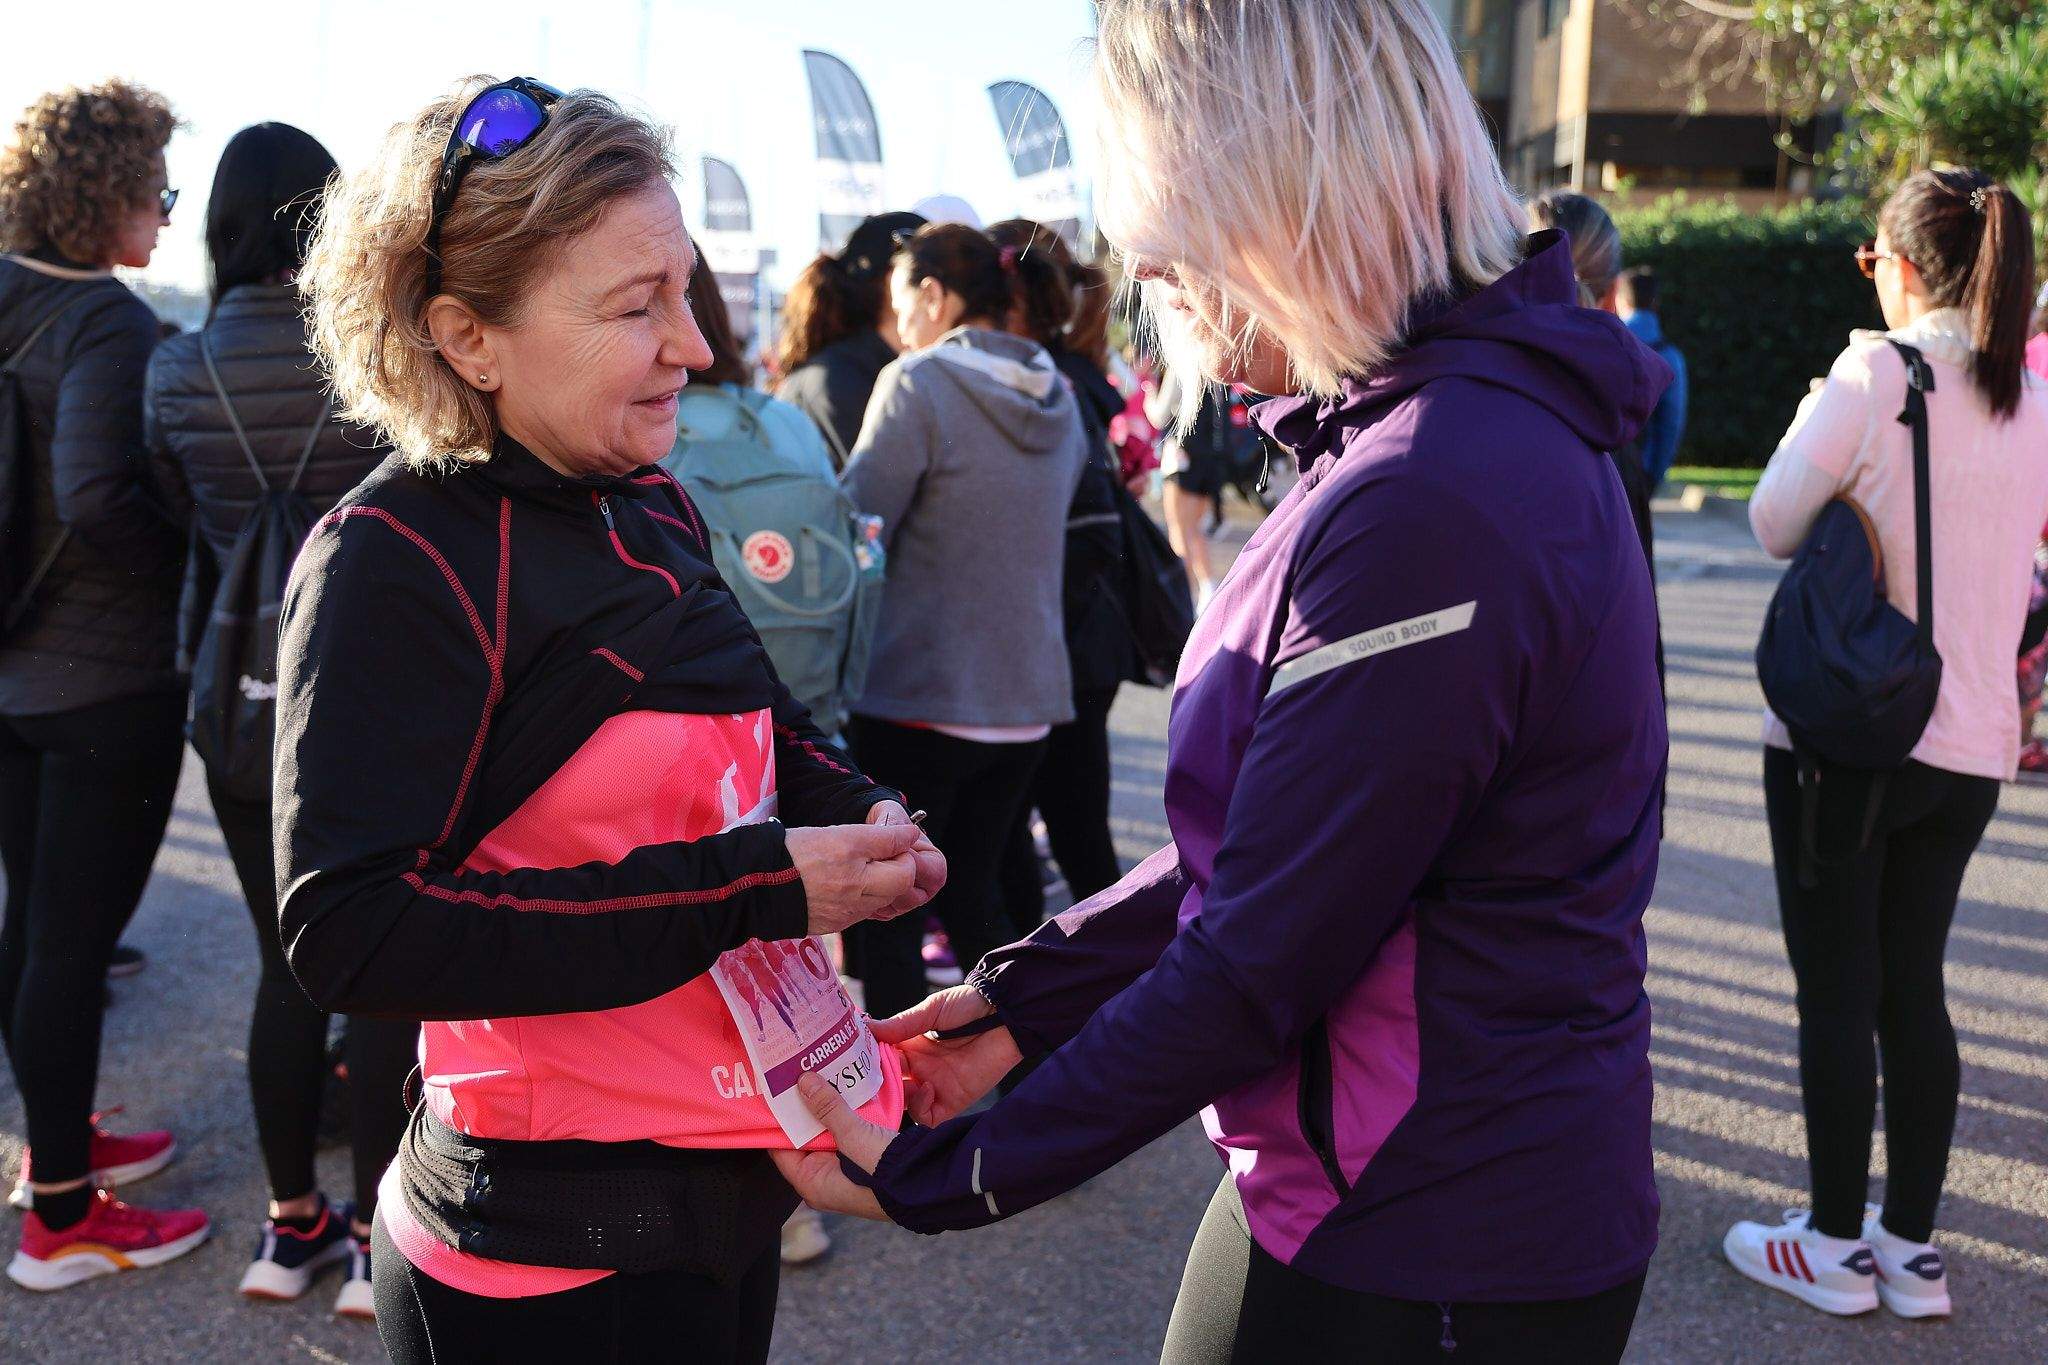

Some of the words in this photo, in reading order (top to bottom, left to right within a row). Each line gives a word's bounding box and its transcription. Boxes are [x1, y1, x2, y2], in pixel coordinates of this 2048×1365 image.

[1348, 632, 1397, 656] SOUND
[1402, 618, 1439, 642] BODY
[800, 1029, 850, 1072] CARRERA
[711, 1061, 764, 1099] CA
[826, 1050, 871, 1095] YSHO
